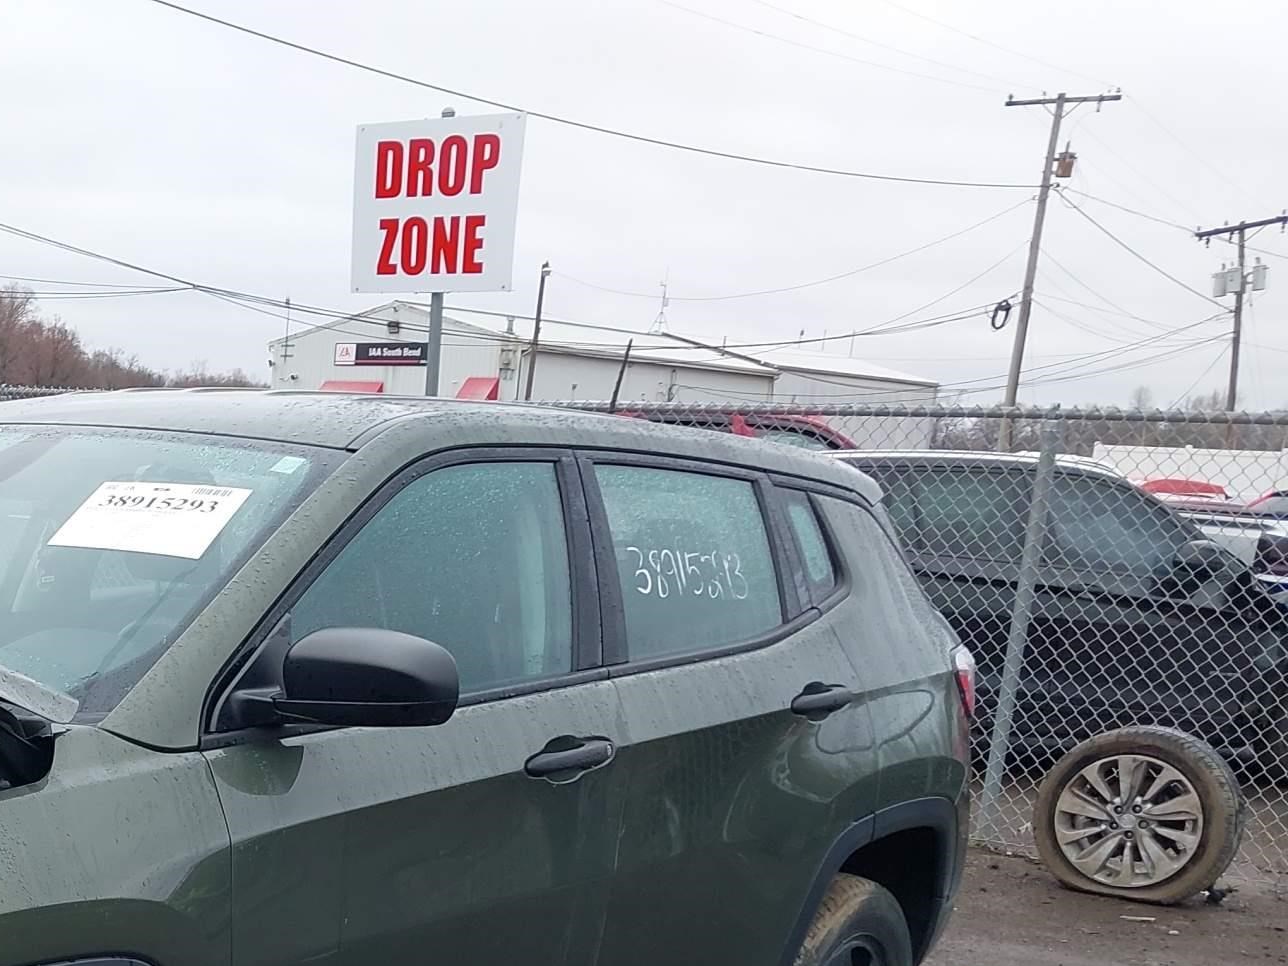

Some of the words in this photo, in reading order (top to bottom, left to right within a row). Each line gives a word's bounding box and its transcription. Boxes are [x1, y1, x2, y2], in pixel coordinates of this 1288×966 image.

[375, 133, 500, 199] DROP
[376, 214, 486, 275] ZONE
[368, 347, 382, 357] IAA
[382, 347, 402, 357] South
[403, 347, 422, 357] Bend
[97, 494, 220, 513] 38915293
